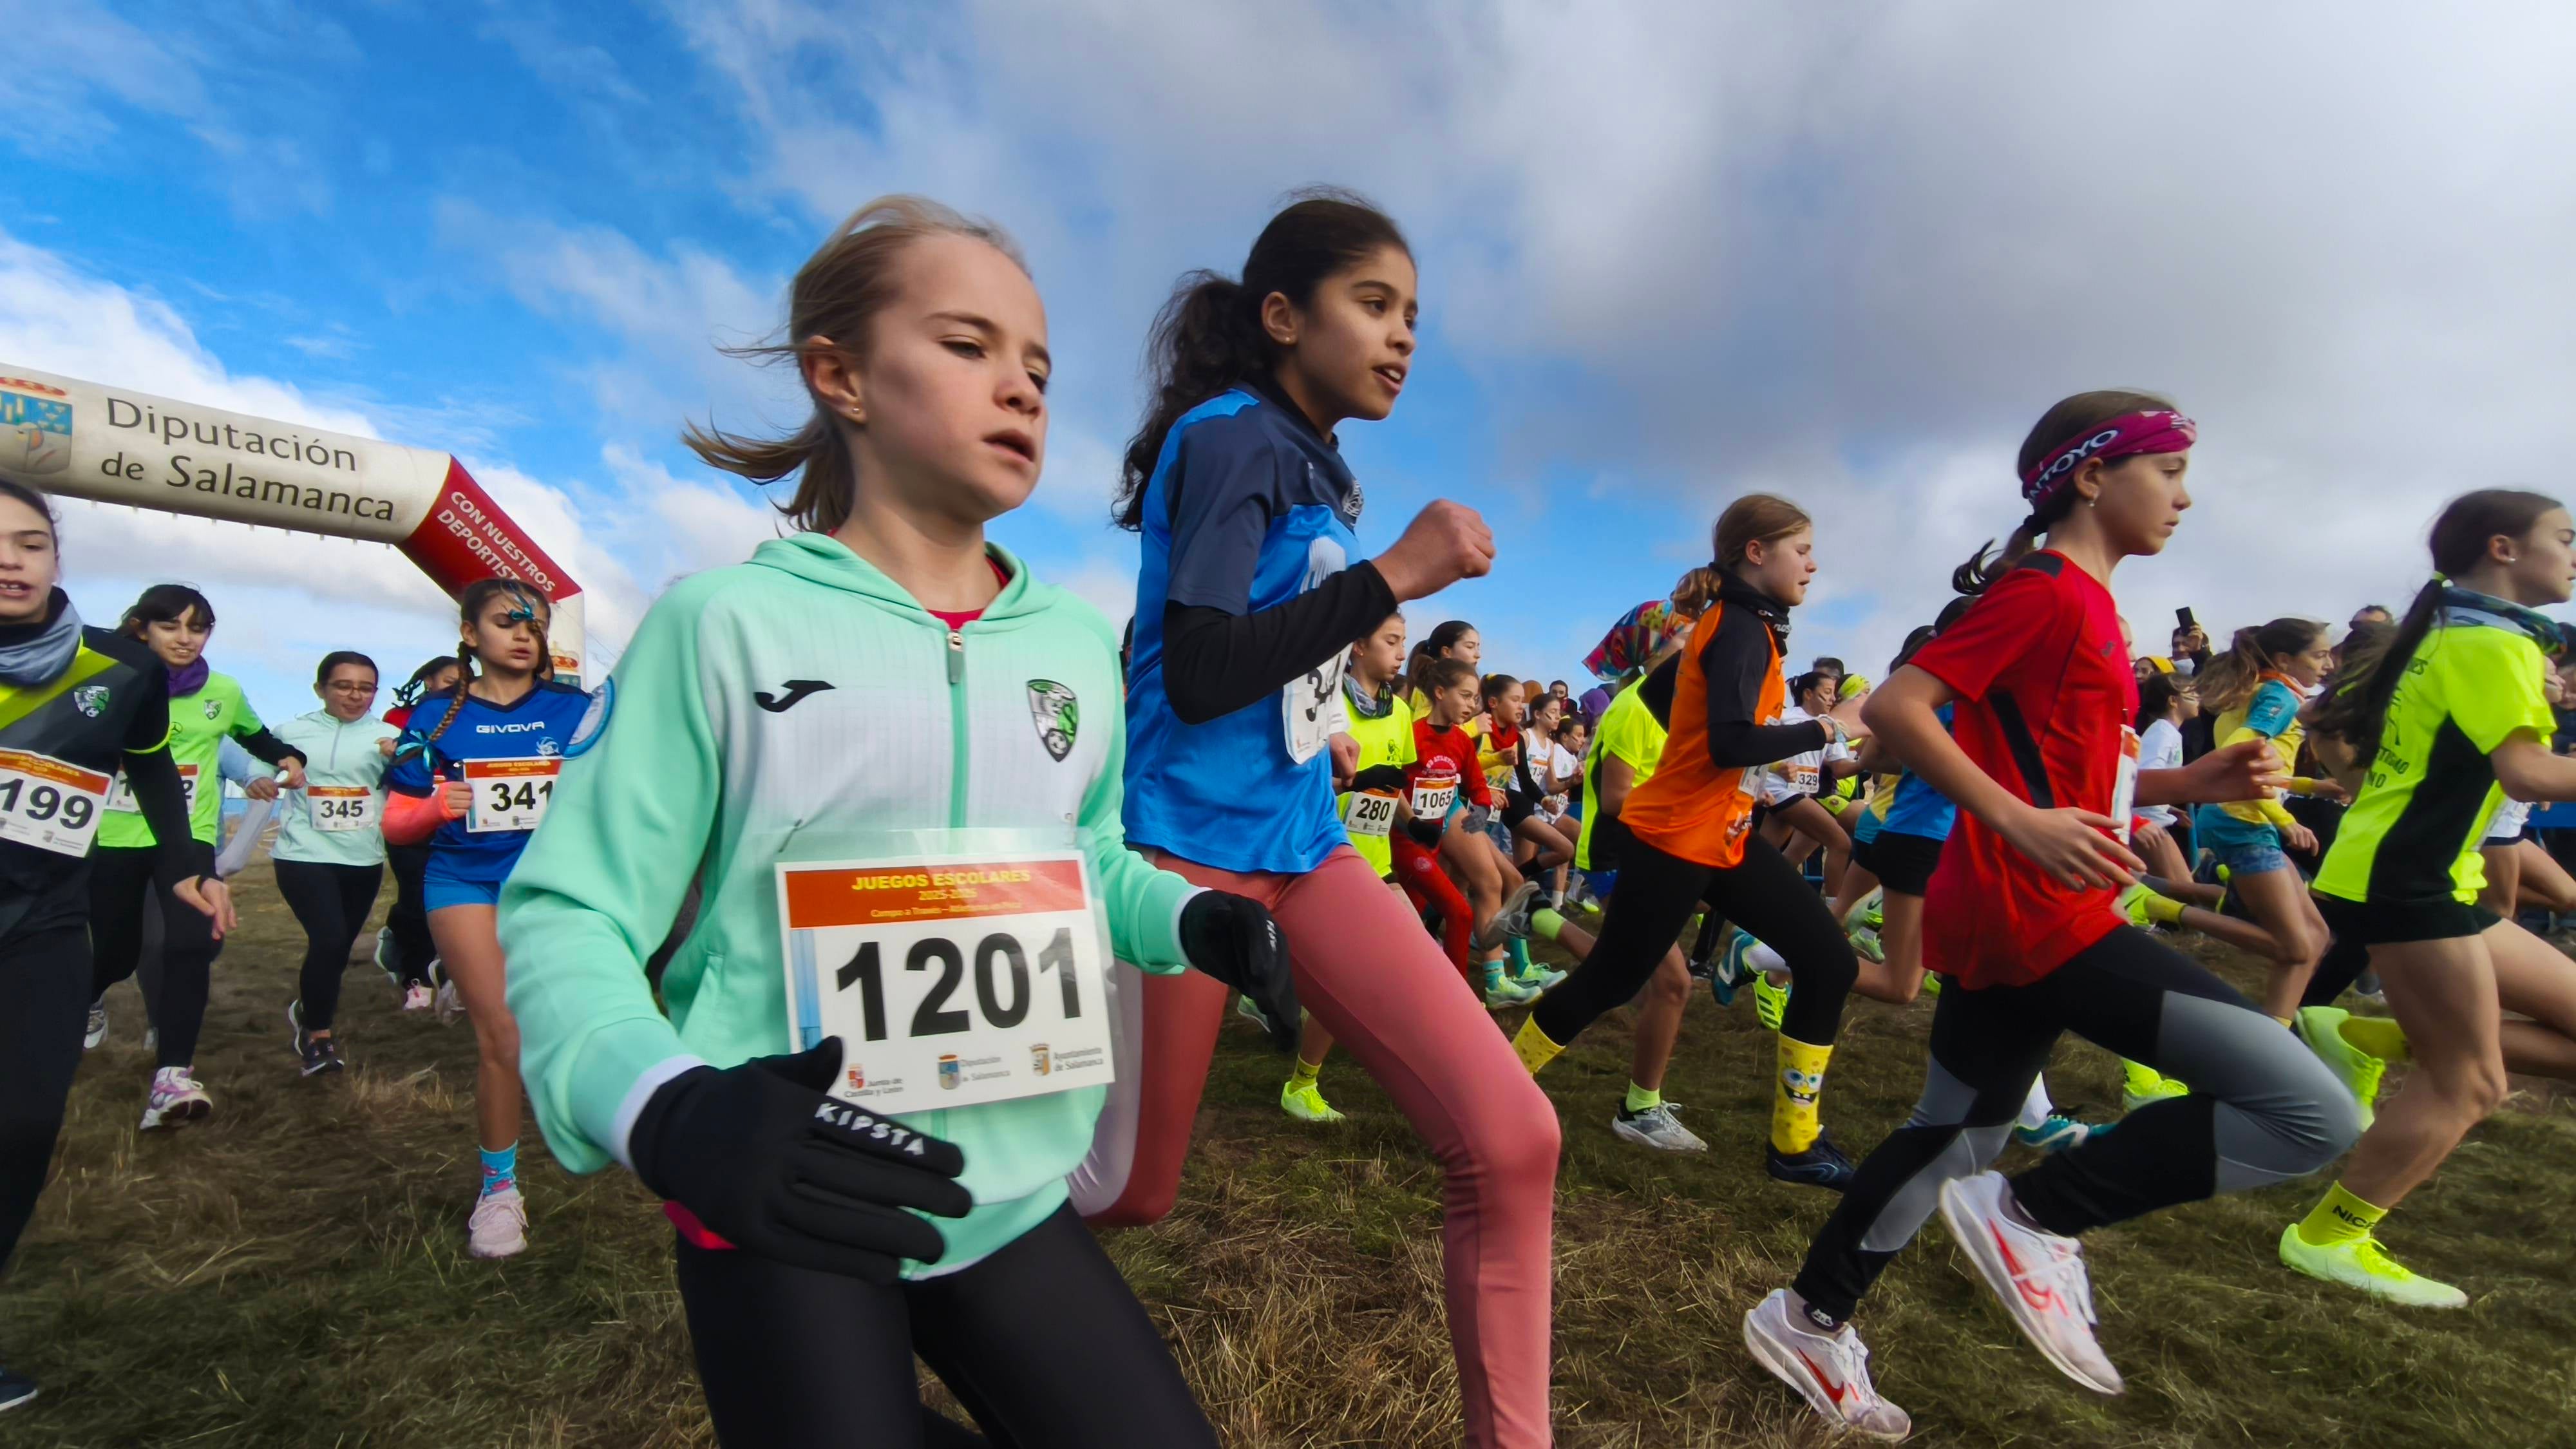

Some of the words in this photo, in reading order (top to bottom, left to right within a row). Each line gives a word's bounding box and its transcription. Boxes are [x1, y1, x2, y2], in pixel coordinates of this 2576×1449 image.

[107, 397, 356, 471] Diputación
[100, 451, 144, 480] de
[166, 455, 394, 521] Salamanca
[451, 491, 486, 525] CON
[482, 522, 556, 592] NUESTROS
[476, 721, 545, 734] GIVOVA
[0, 778, 94, 829] 199
[320, 800, 363, 819] 345
[491, 781, 553, 812] 341
[1356, 797, 1390, 822] 280
[1420, 791, 1453, 808] 1065
[851, 873, 929, 891] JUEGOS
[933, 870, 1032, 887] ESCOLARES
[836, 927, 1081, 1042] 1201
[815, 1103, 925, 1155] KIPSTA
